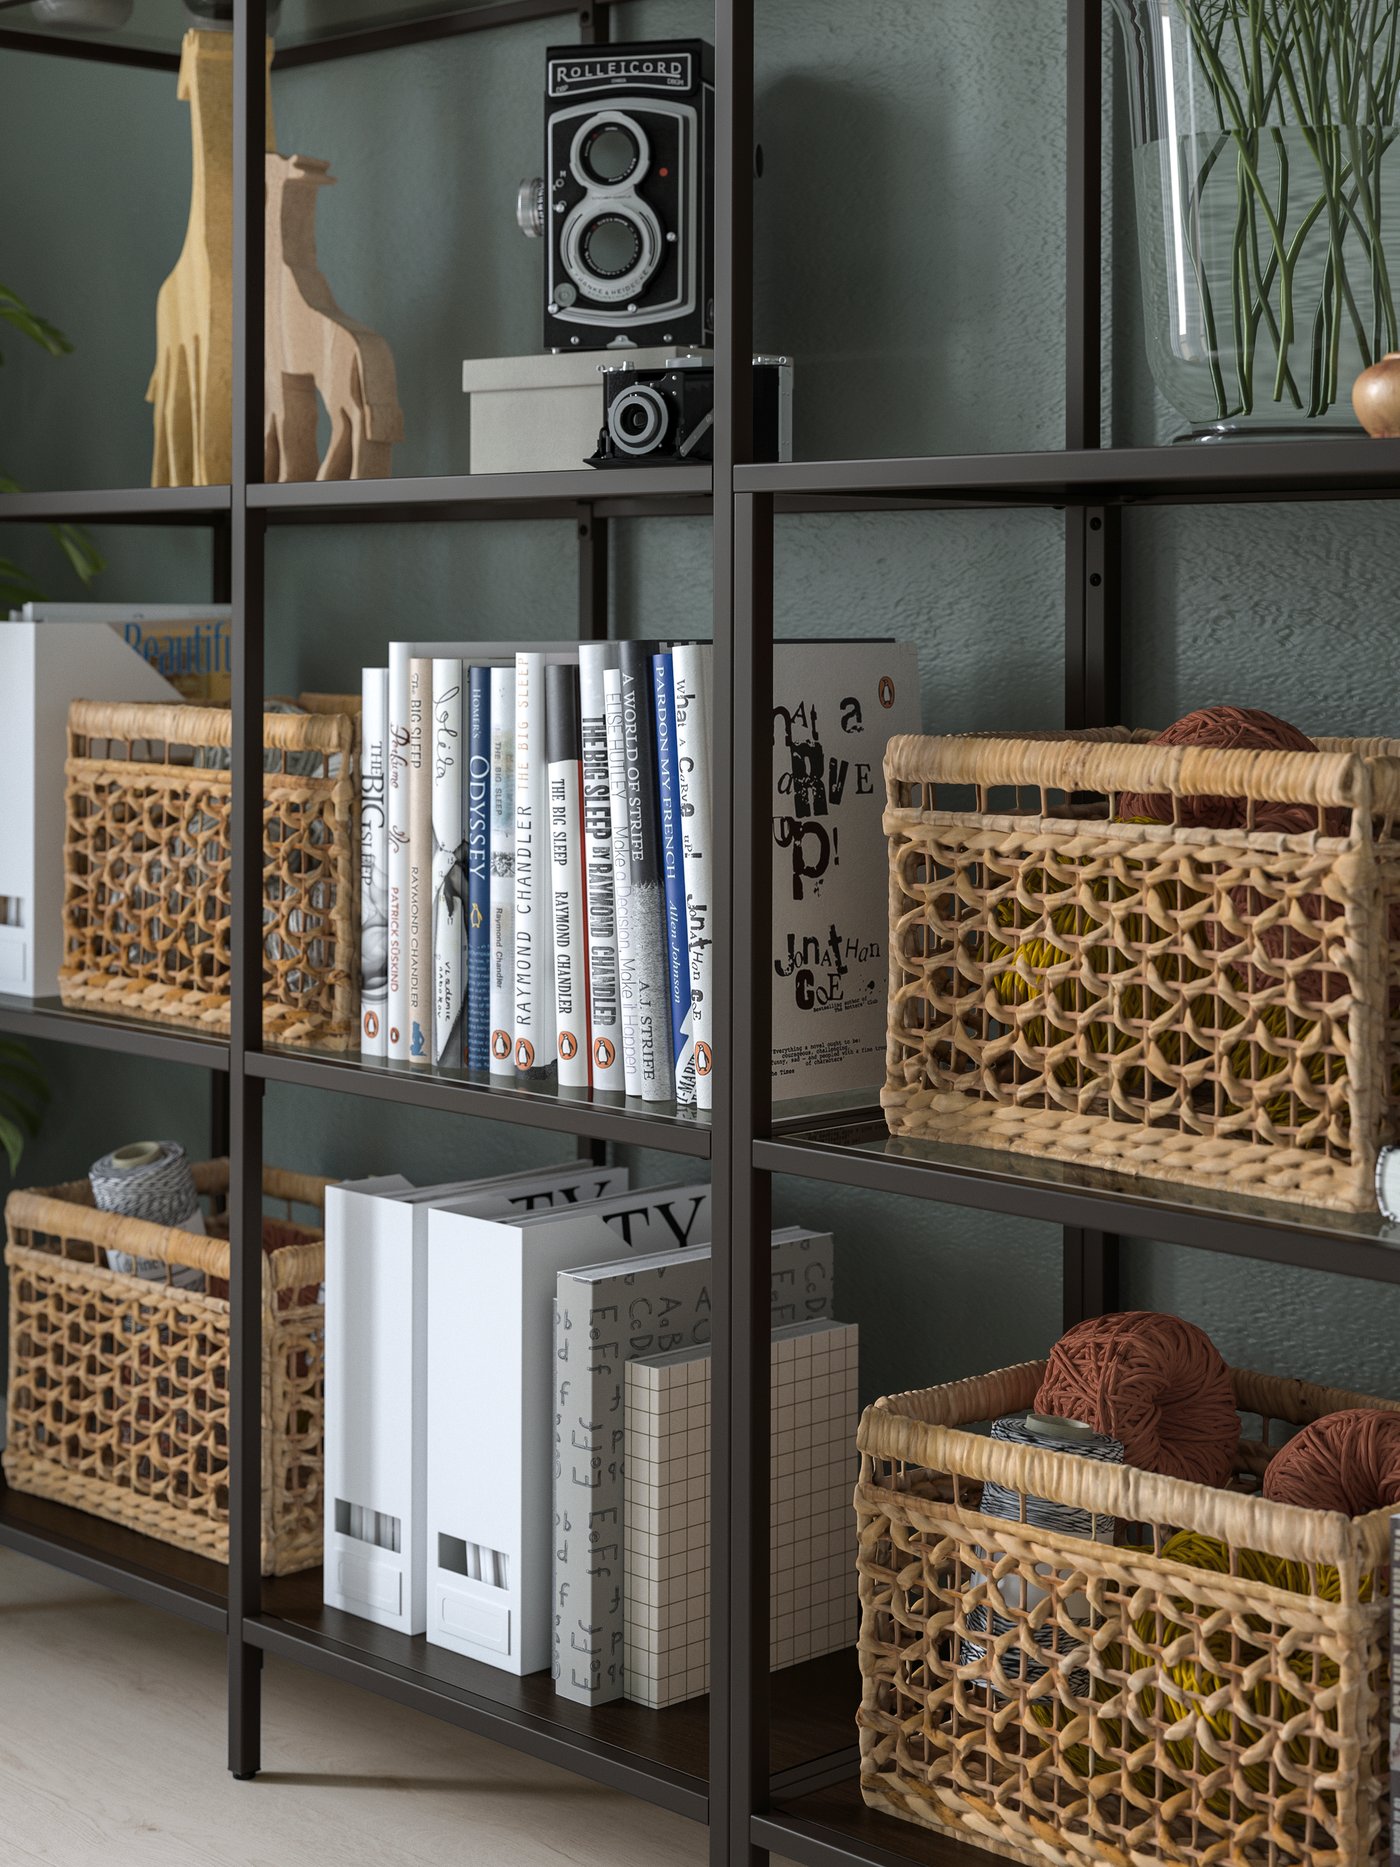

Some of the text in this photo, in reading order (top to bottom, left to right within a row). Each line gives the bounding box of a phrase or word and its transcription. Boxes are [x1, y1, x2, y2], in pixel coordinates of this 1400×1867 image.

[557, 61, 682, 82] ROLLEICORD
[411, 700, 421, 722] BIG
[518, 657, 529, 790] THE BIG SLEEP
[606, 693, 627, 800] ELISE HUTLEY
[679, 738, 686, 747] A
[840, 697, 864, 733] a
[371, 741, 383, 775] THE
[390, 723, 411, 789] Perfume
[494, 742, 503, 816] THE BIG SLEEP
[623, 673, 644, 862] A WORLD OF STRIFE
[656, 666, 676, 879] PARDON MY FRENCH
[777, 741, 874, 818] aRVE
[361, 772, 385, 831] BIG
[470, 755, 490, 880] ODYSSEY
[552, 779, 567, 865] THE BIG SLEEP
[582, 714, 617, 1026] THE BIG SLEEP BY RAYMOND CHANDLER
[613, 826, 630, 867] Make
[615, 871, 625, 881] a
[390, 887, 399, 992] PATRICK SÜSKIND
[410, 866, 419, 1008] RAYMOND CHANDLER
[495, 907, 504, 989] Raymond Chandler
[517, 805, 532, 1026] RAYMOND CHANDLER
[555, 891, 572, 1014] RAYMOND CHANDLER
[669, 899, 681, 1004] Allen Johnson
[620, 957, 636, 999] Make
[622, 1002, 634, 1013] it
[623, 1014, 639, 1074] Happen
[638, 981, 655, 1080] A.J. STRIFE
